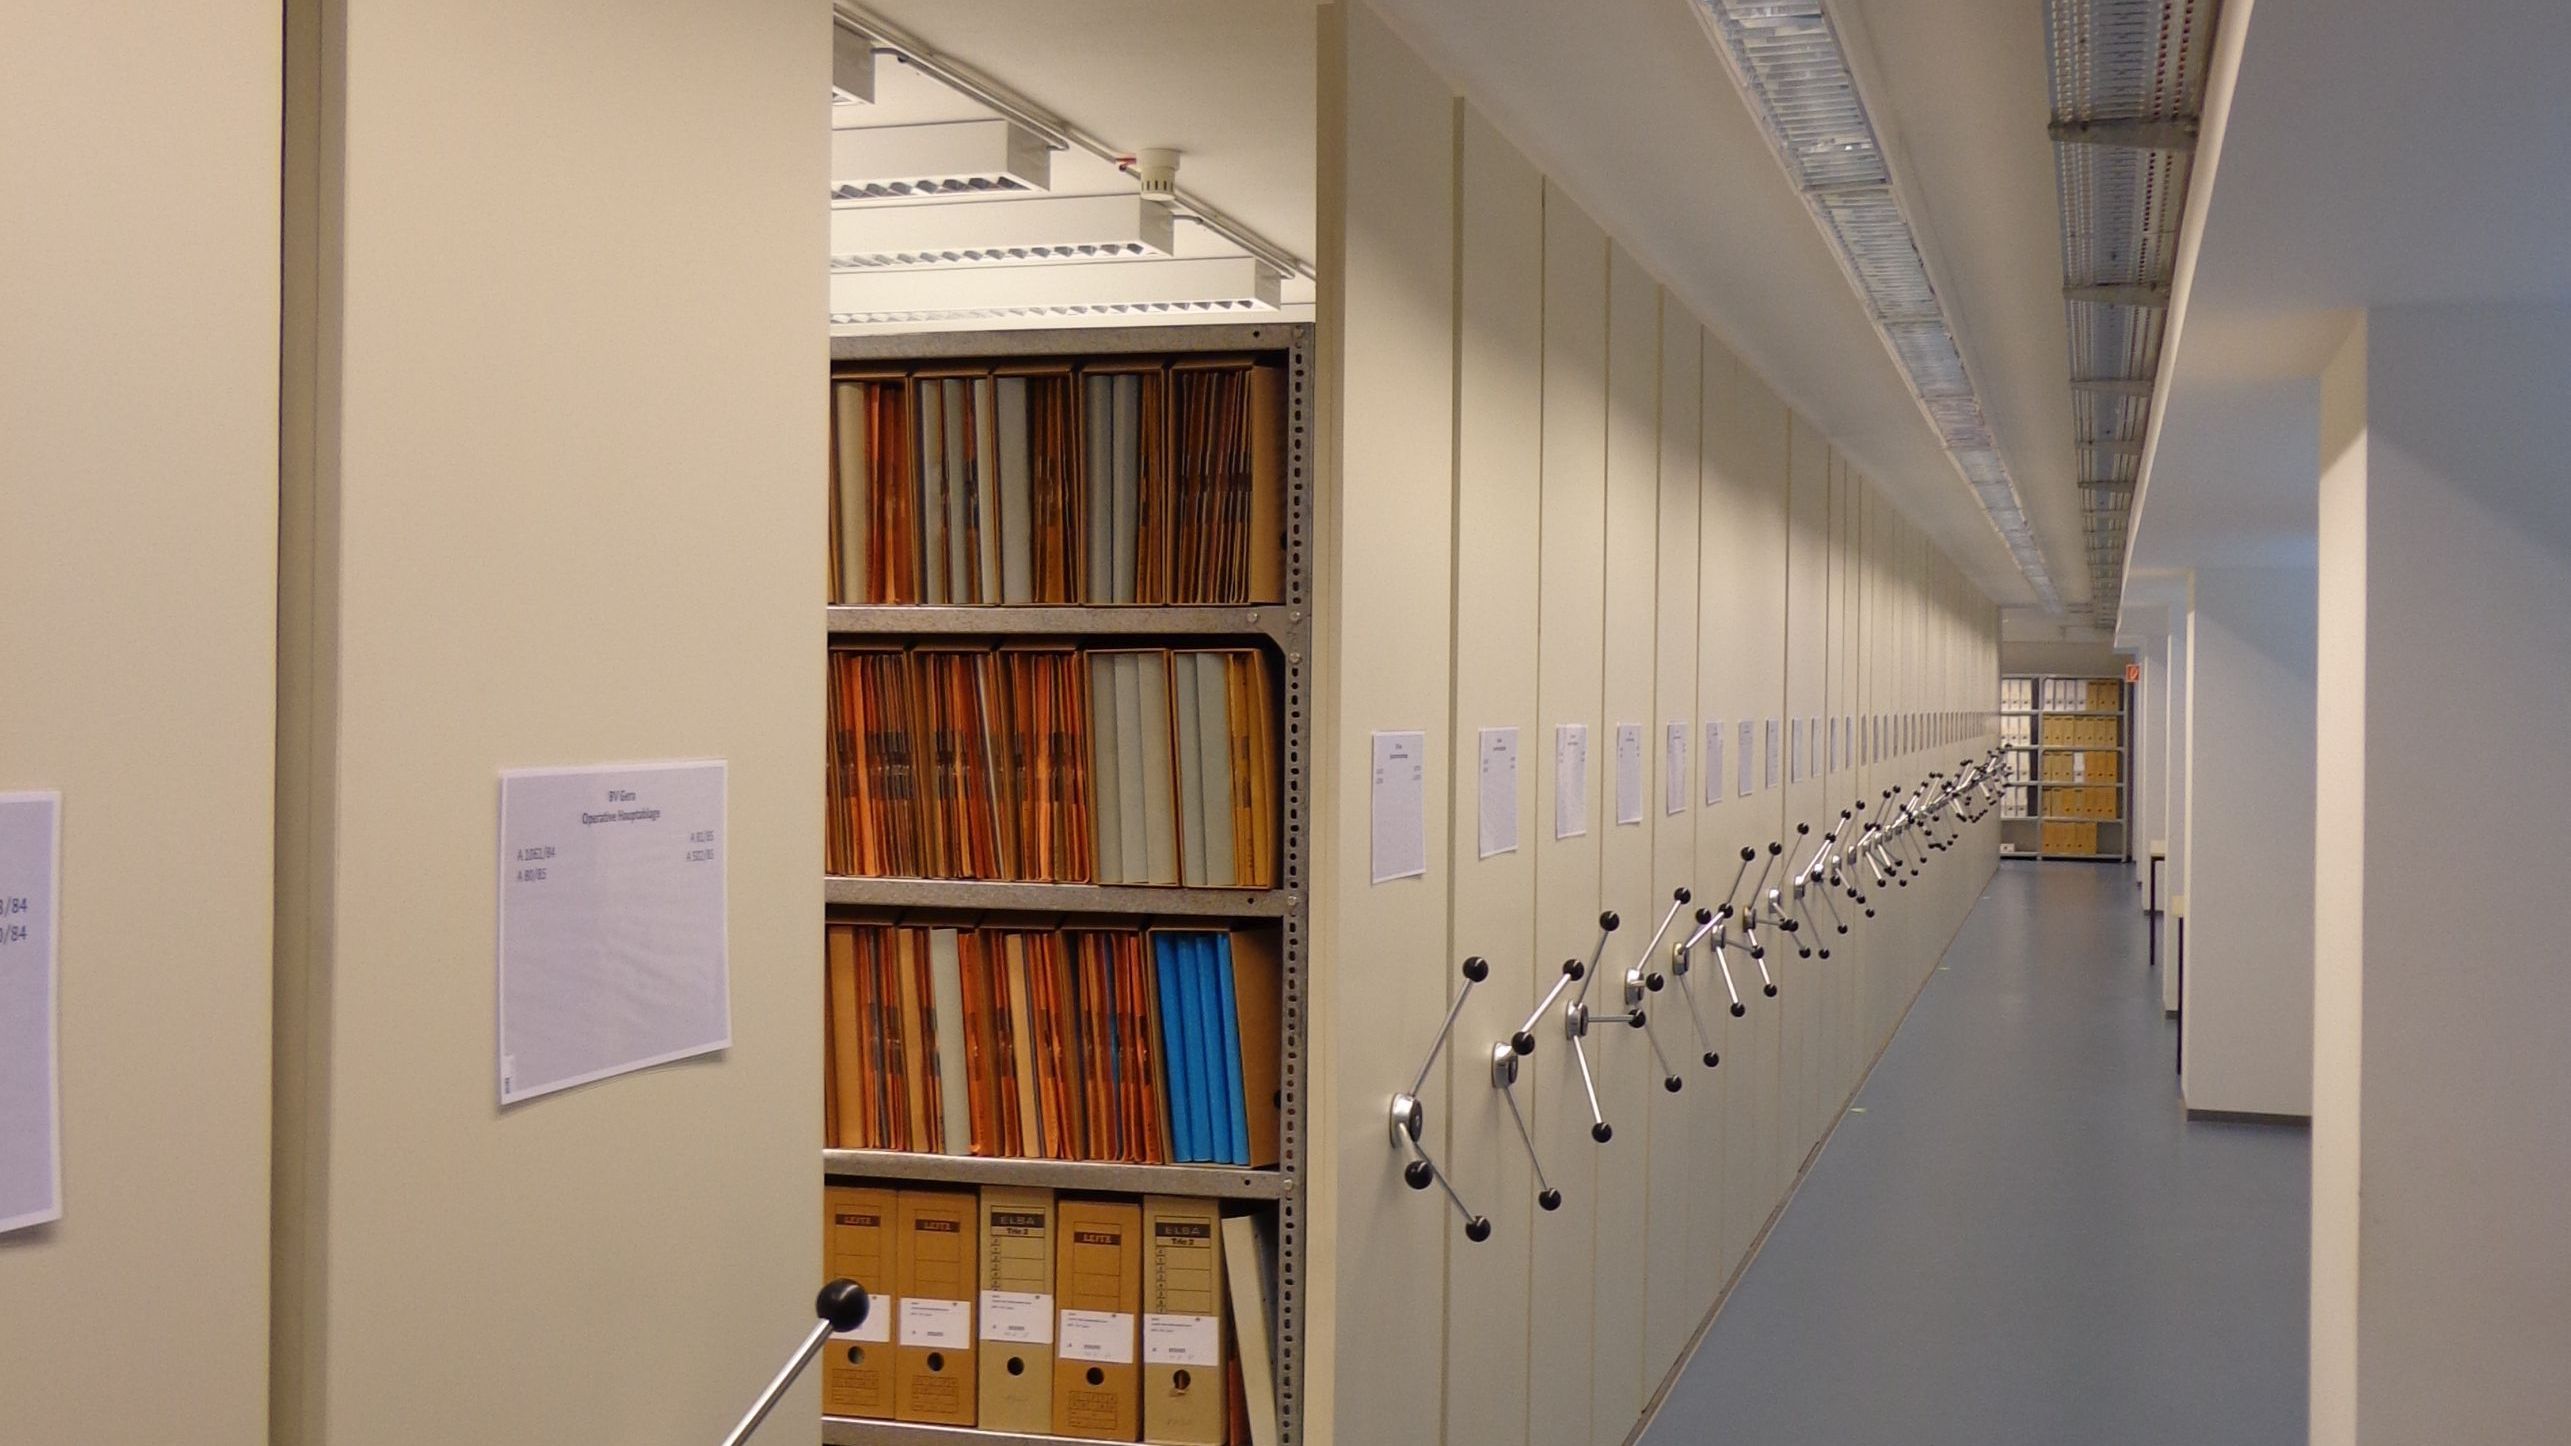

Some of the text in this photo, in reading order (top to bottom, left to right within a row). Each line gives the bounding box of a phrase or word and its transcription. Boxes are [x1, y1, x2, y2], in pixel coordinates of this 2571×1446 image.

[582, 812, 617, 827] Operative
[1000, 1215, 1034, 1225] ELBA
[1164, 1226, 1200, 1236] ELBA
